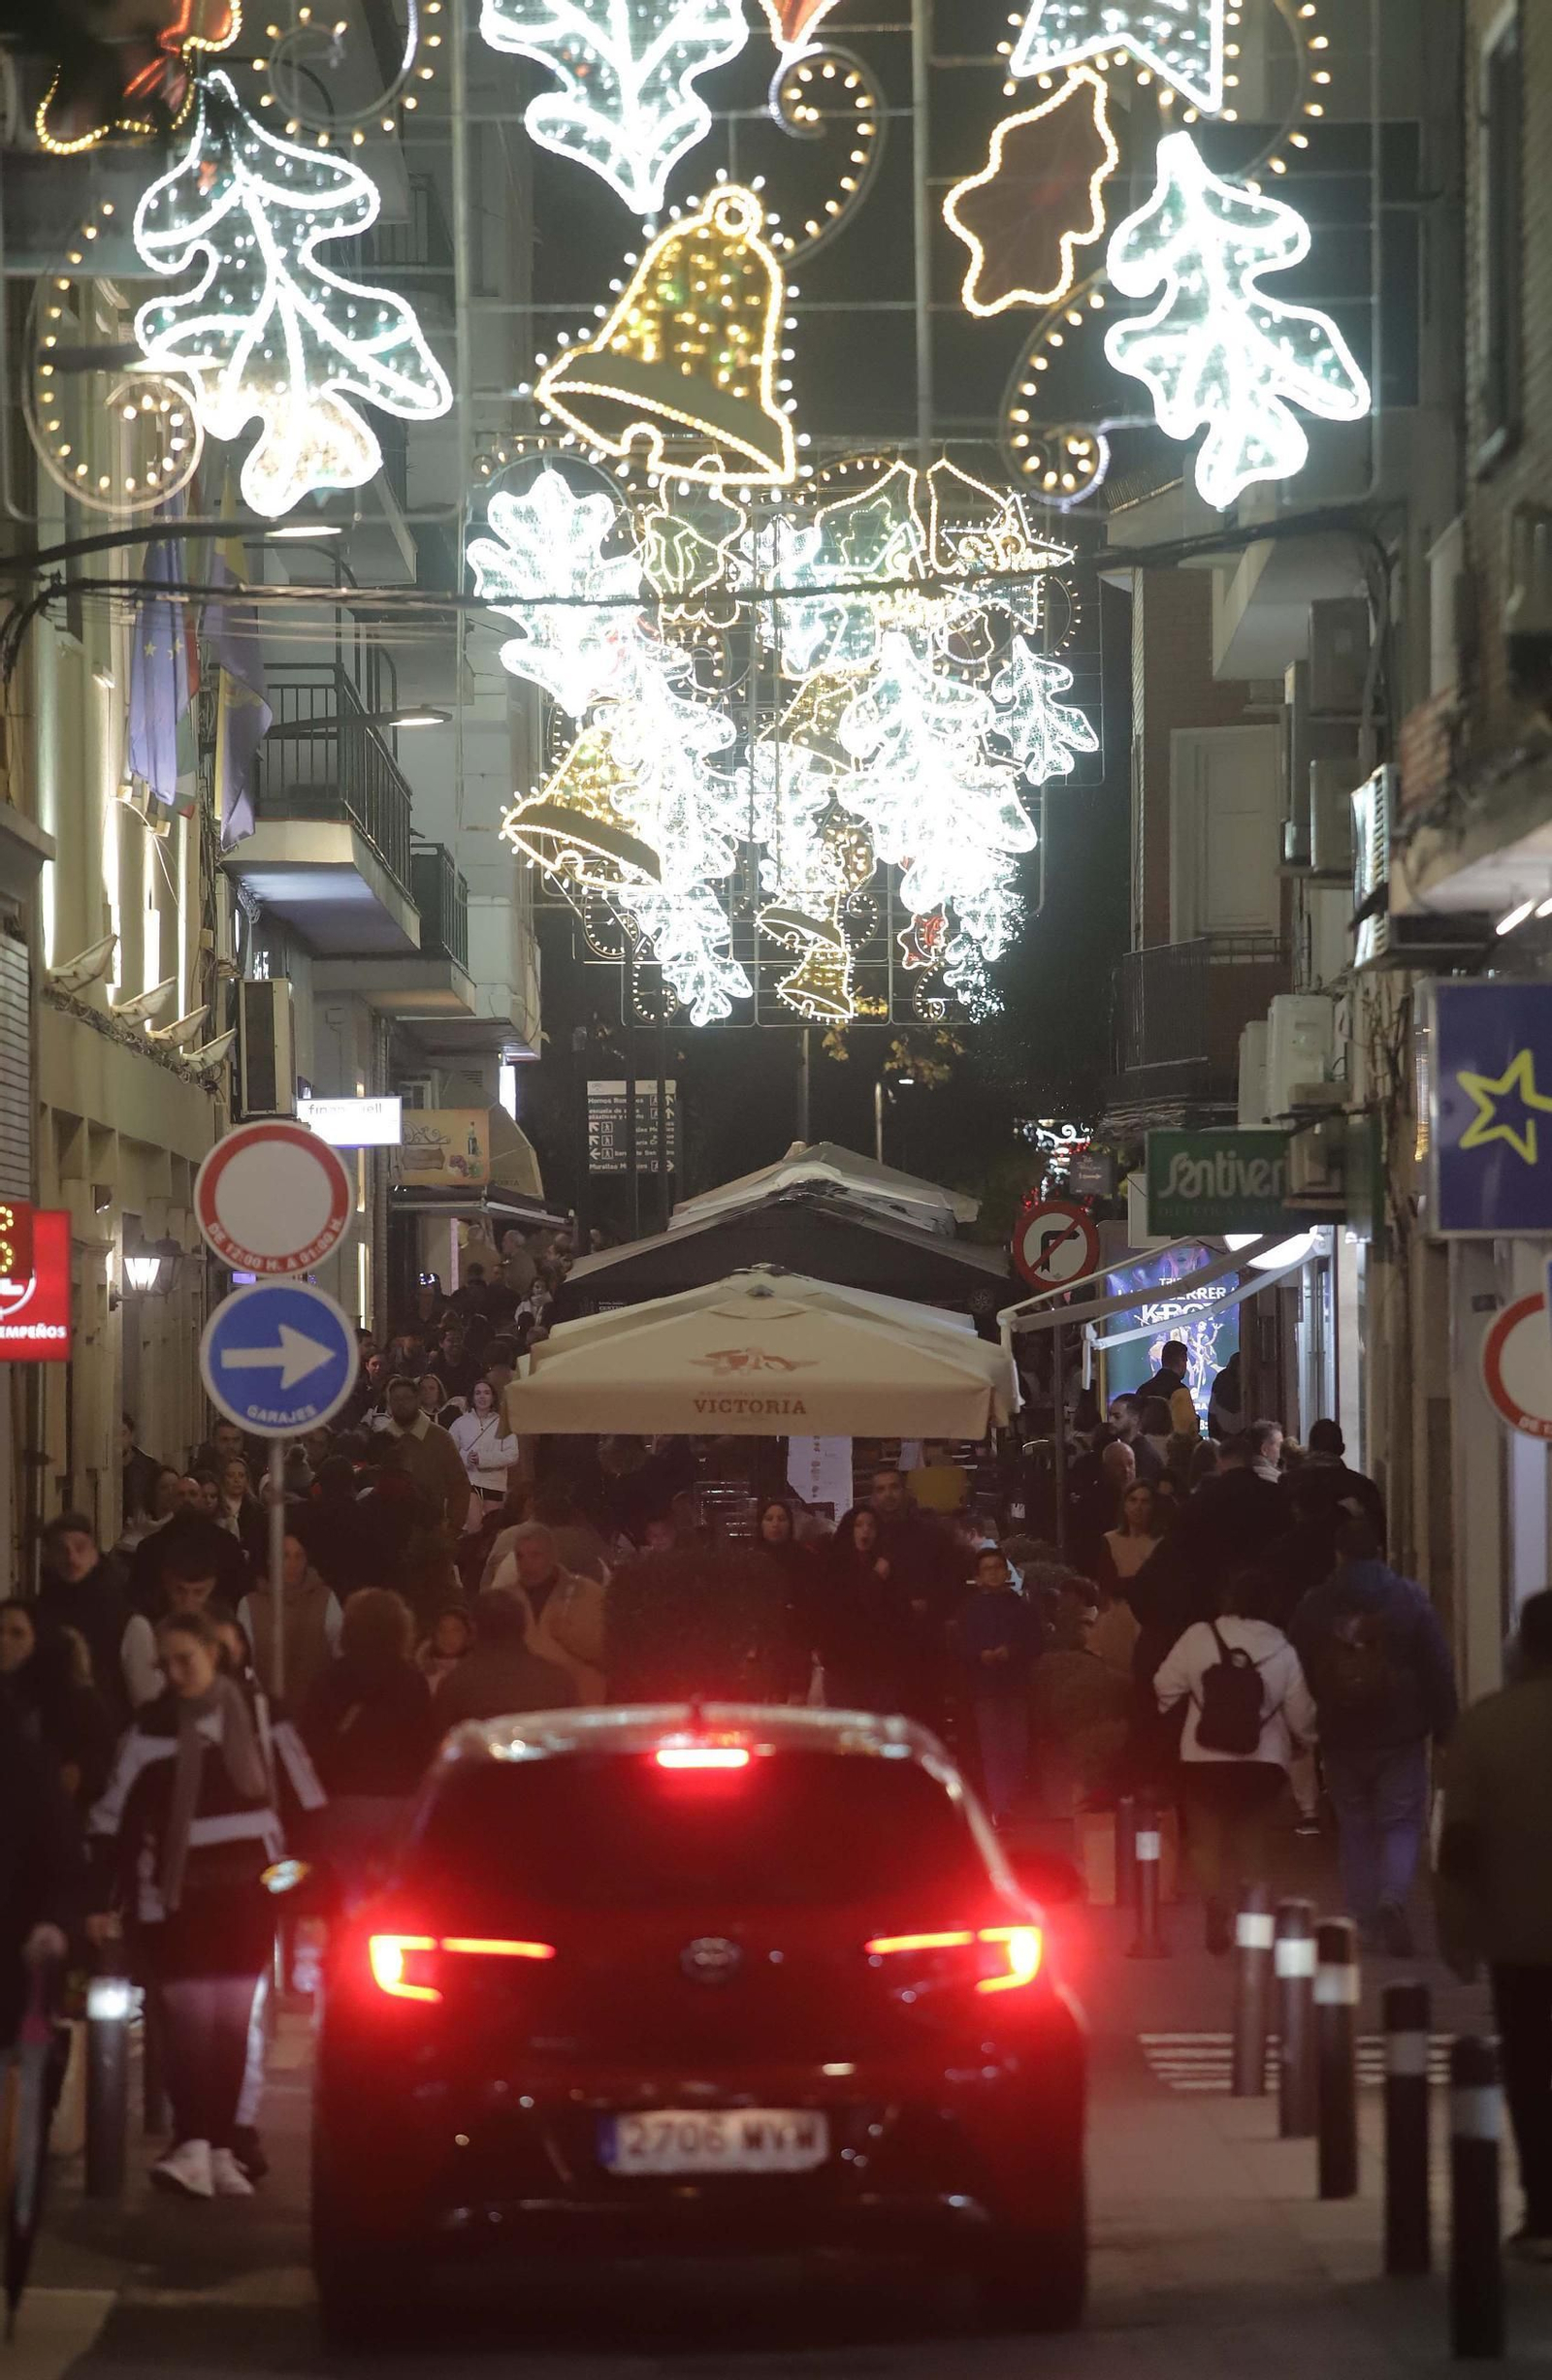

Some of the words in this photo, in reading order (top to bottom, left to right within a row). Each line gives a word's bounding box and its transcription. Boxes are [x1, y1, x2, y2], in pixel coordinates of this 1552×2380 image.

[208, 1222, 227, 1245] DE
[287, 1258, 298, 1270] A
[247, 1404, 317, 1424] GARAJES
[693, 1399, 807, 1415] VICTORIA
